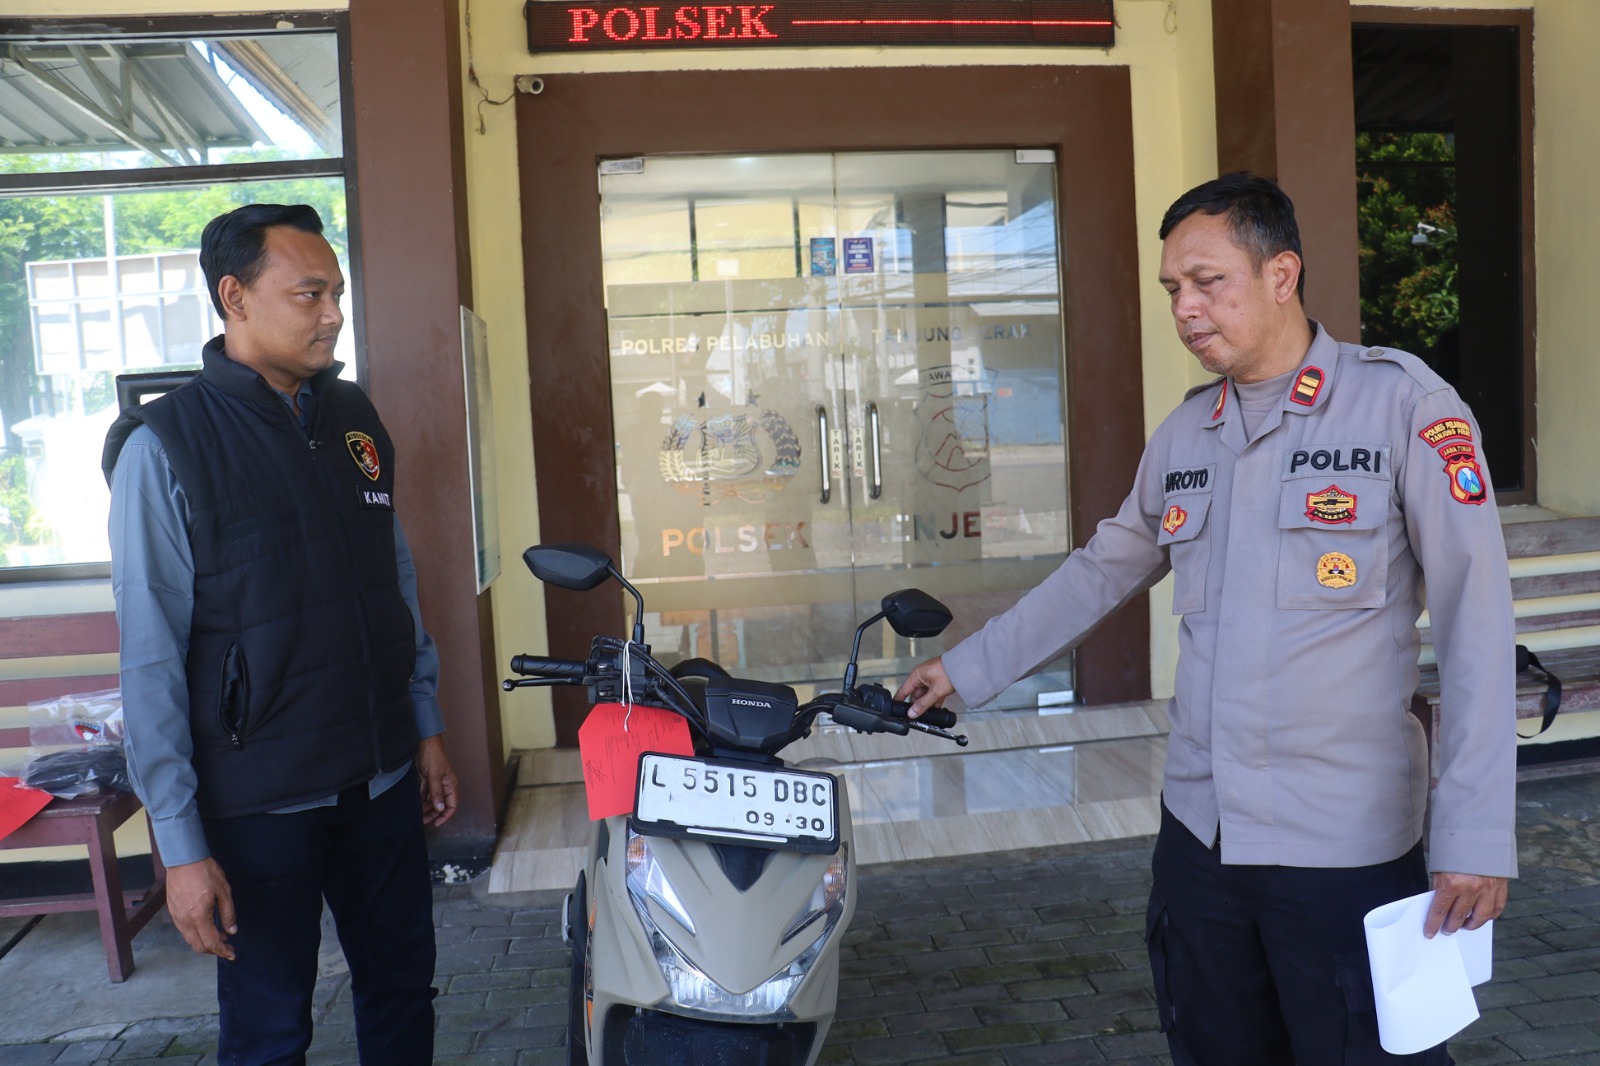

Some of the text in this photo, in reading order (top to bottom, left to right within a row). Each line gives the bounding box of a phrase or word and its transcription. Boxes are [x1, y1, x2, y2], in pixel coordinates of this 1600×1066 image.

[567, 5, 779, 42] POLSEK
[621, 337, 699, 356] POLRES
[706, 331, 830, 351] PELABUHAN
[833, 430, 841, 469] TARIK
[855, 429, 863, 468] TARIK
[1290, 447, 1381, 474] POLRI
[661, 521, 810, 557] POLSEK
[731, 698, 773, 709] HONDA
[651, 763, 827, 807] L 5515 DBC
